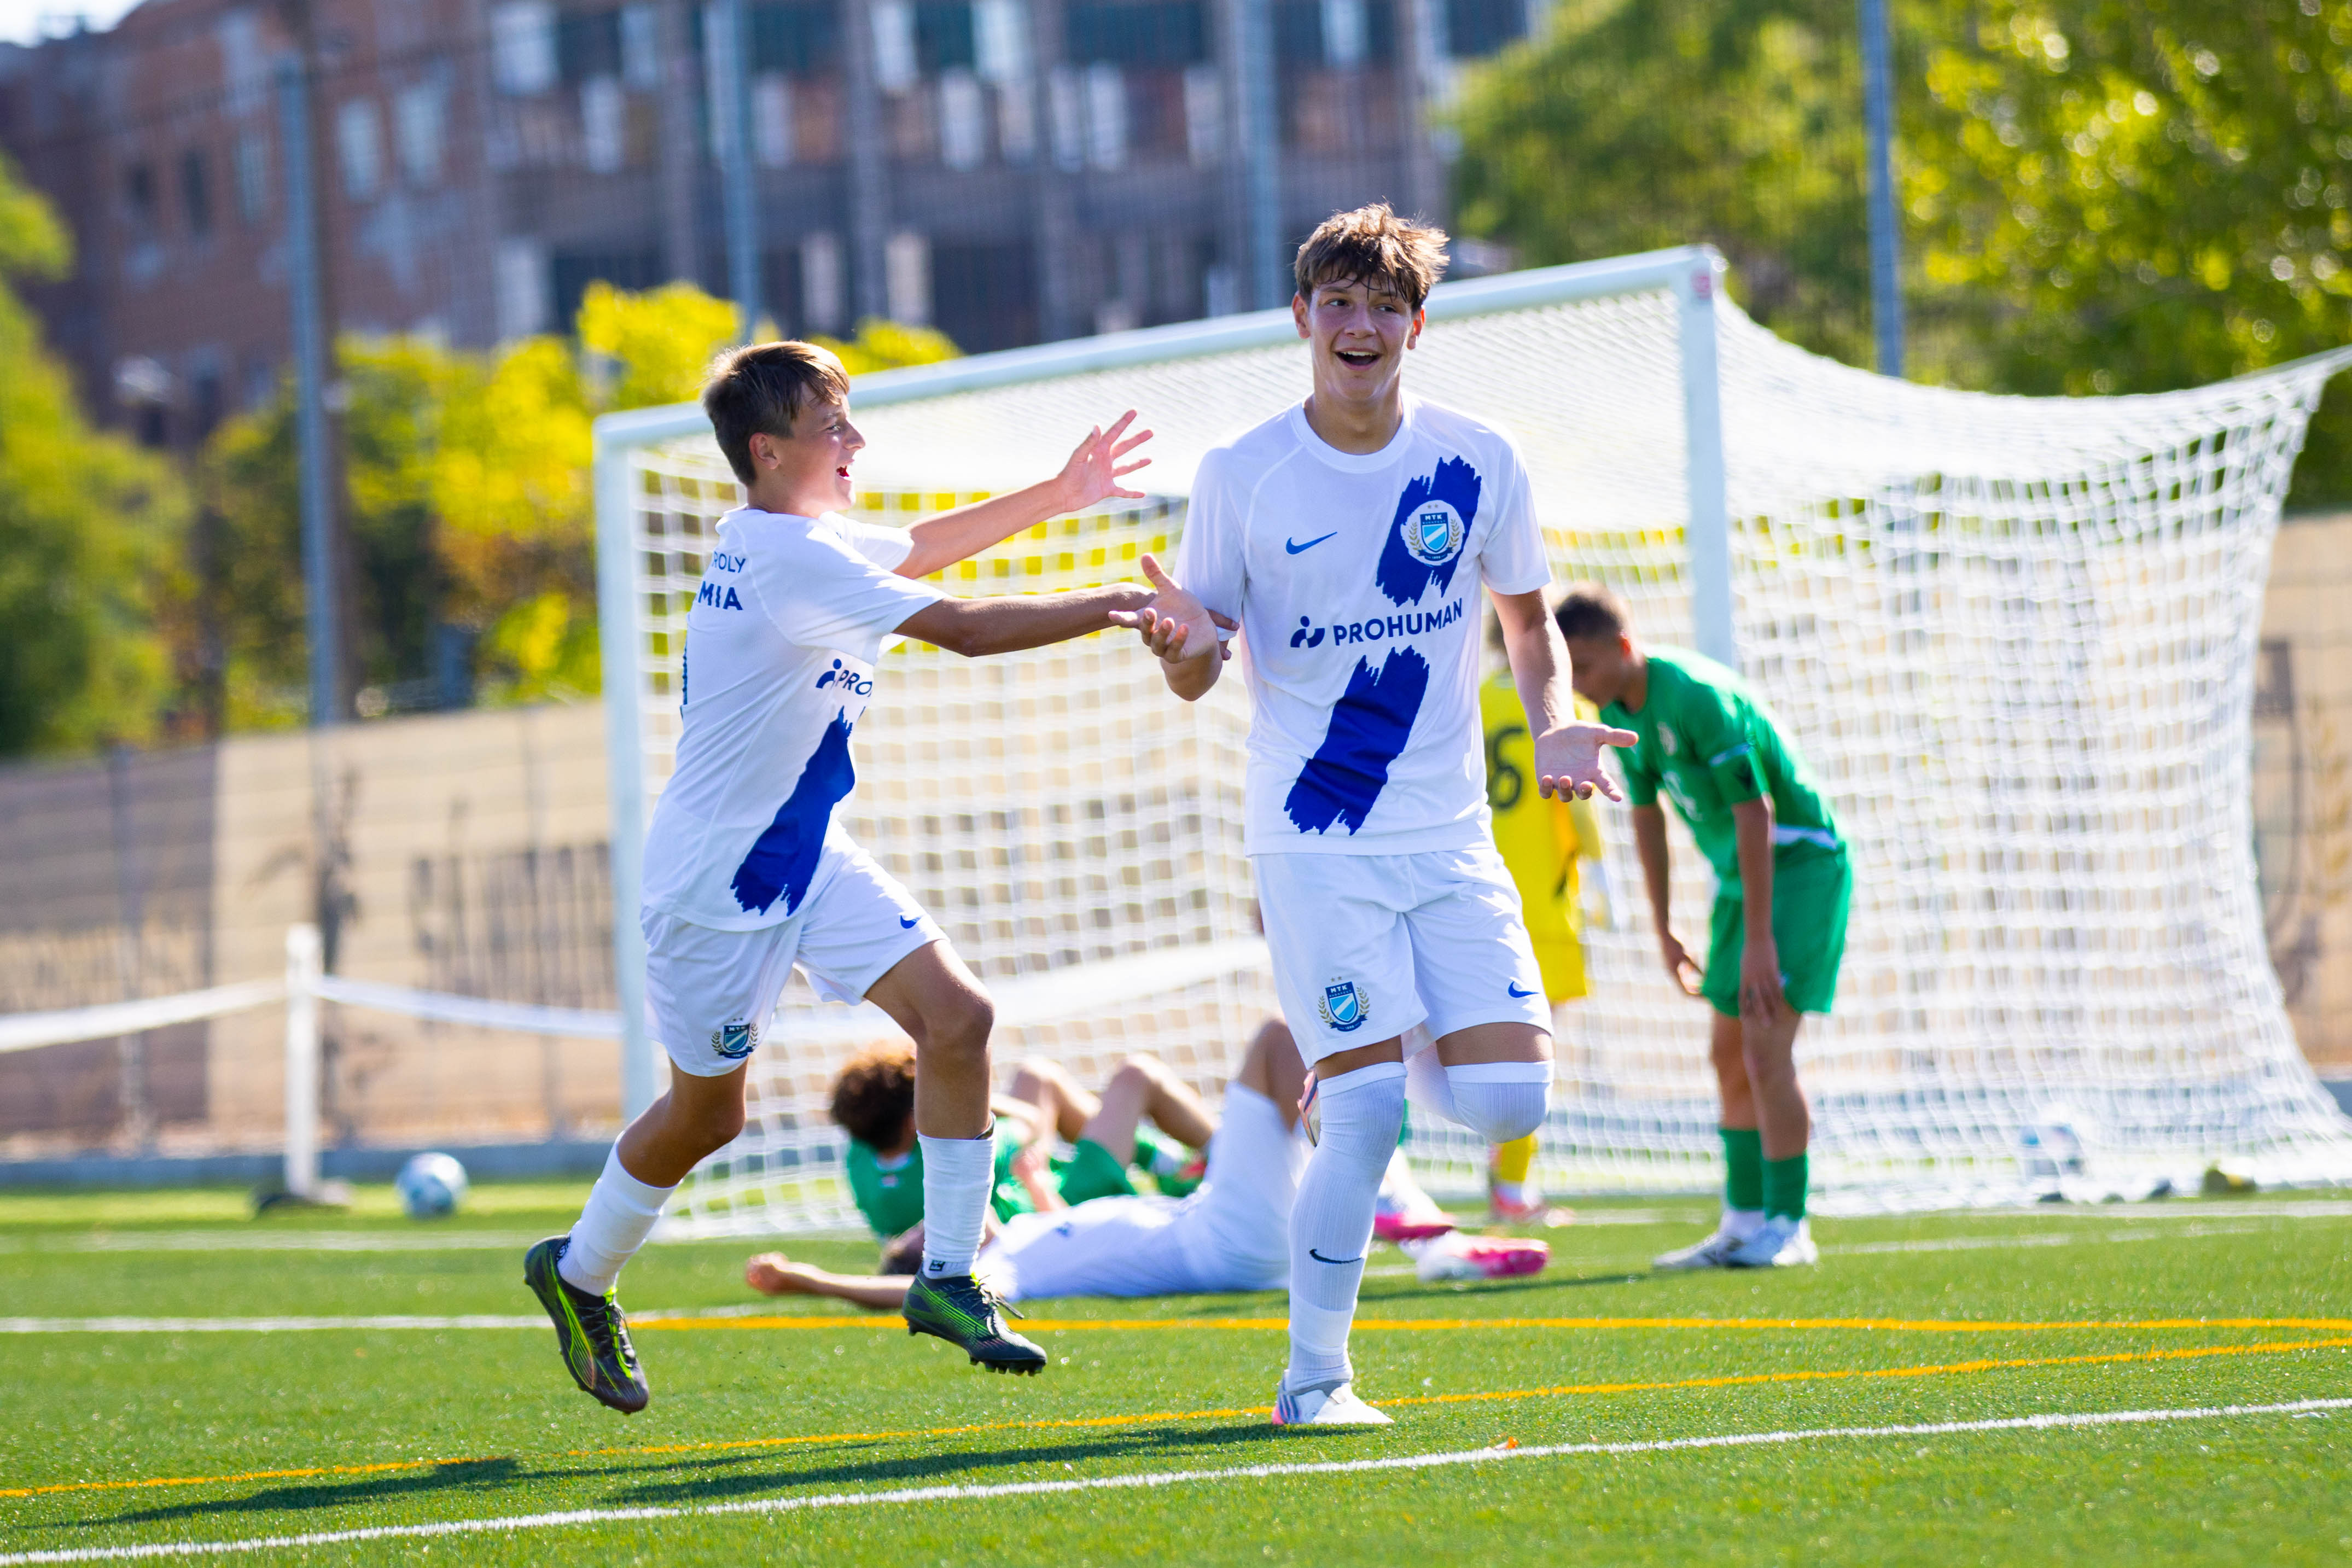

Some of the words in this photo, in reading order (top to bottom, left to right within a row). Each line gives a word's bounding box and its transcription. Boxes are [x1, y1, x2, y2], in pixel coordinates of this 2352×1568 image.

[698, 581, 743, 610] MIA
[1333, 598, 1462, 646] PROHUMAN
[835, 669, 872, 697] PRO
[1330, 984, 1347, 993] MTK
